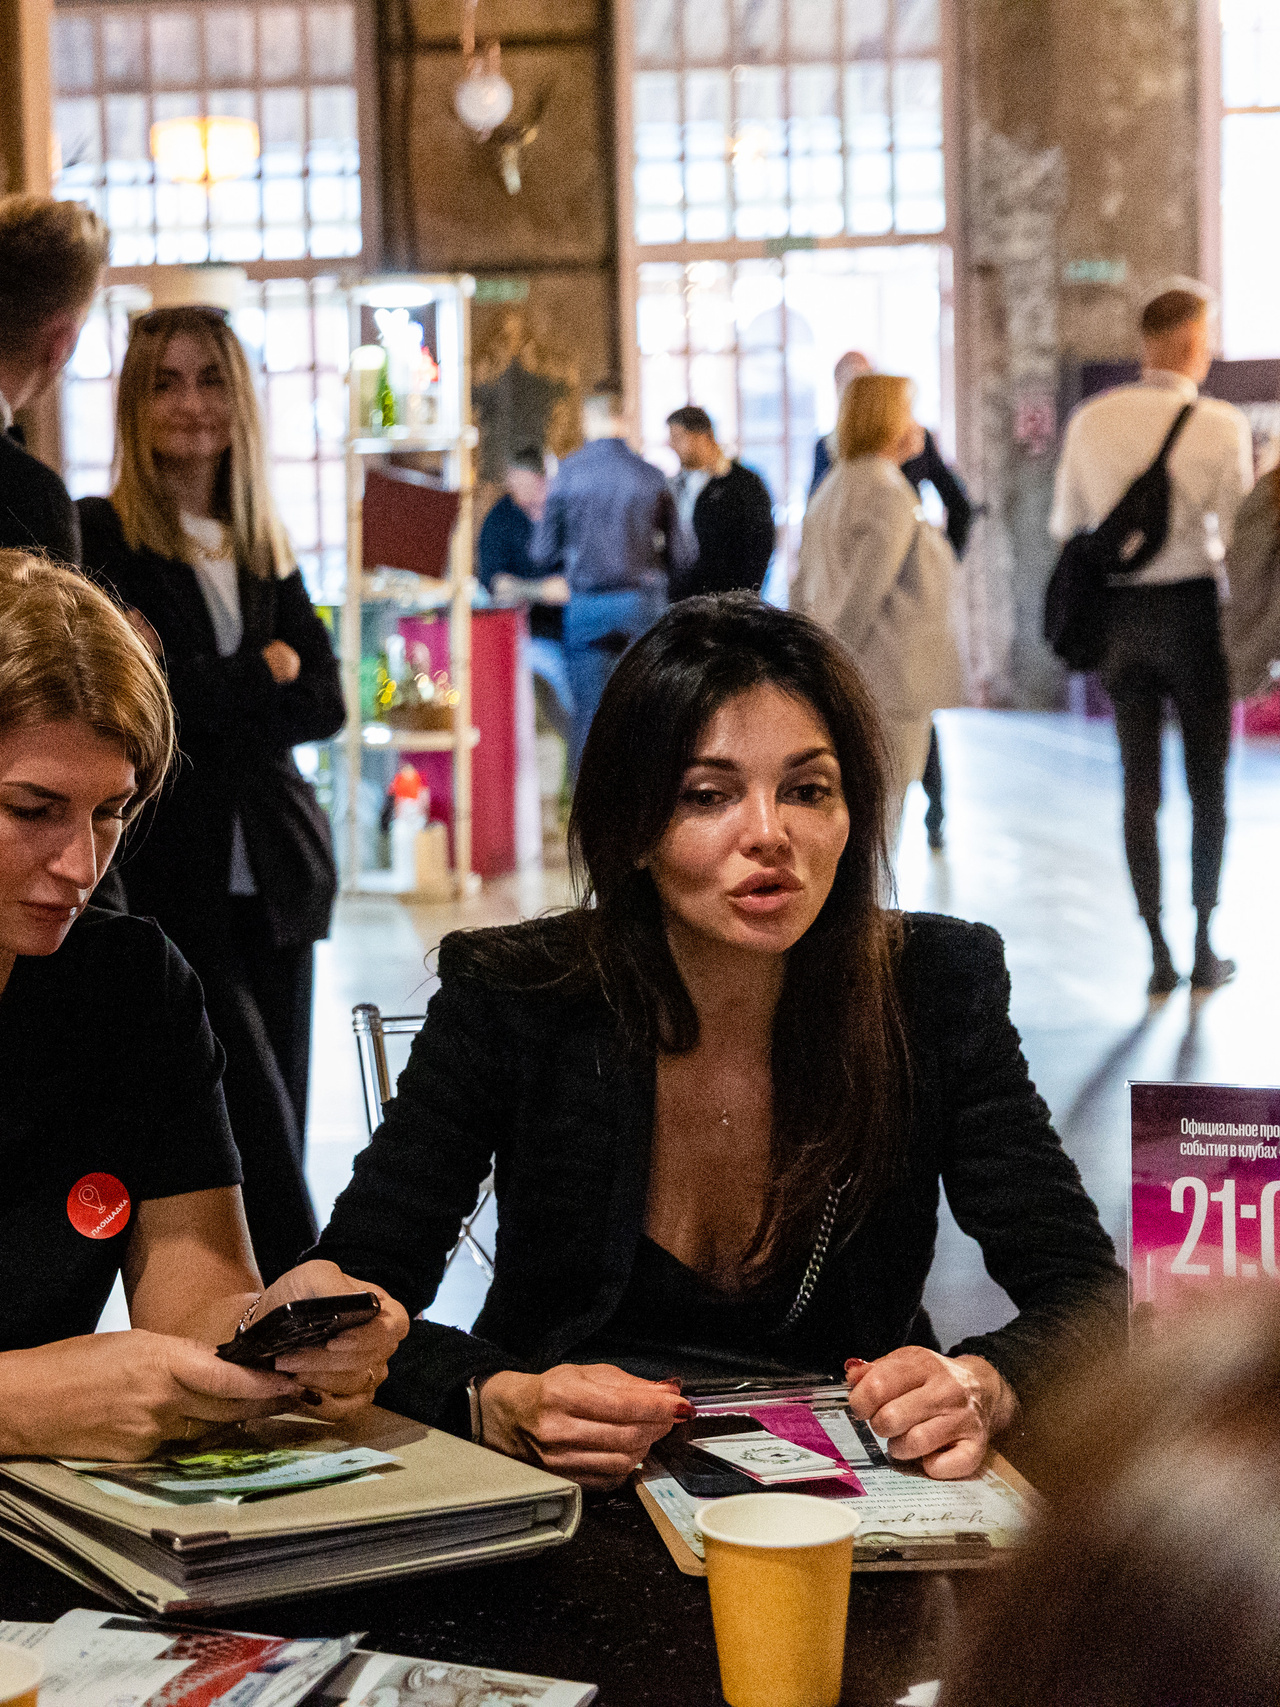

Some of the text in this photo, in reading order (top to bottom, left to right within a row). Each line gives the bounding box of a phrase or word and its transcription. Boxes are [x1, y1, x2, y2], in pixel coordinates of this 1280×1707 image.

[1181, 1117, 1258, 1139] Официальное
[1180, 1140, 1277, 1161] события в клубах
[91, 1199, 128, 1236] ПЛОЩАДКА
